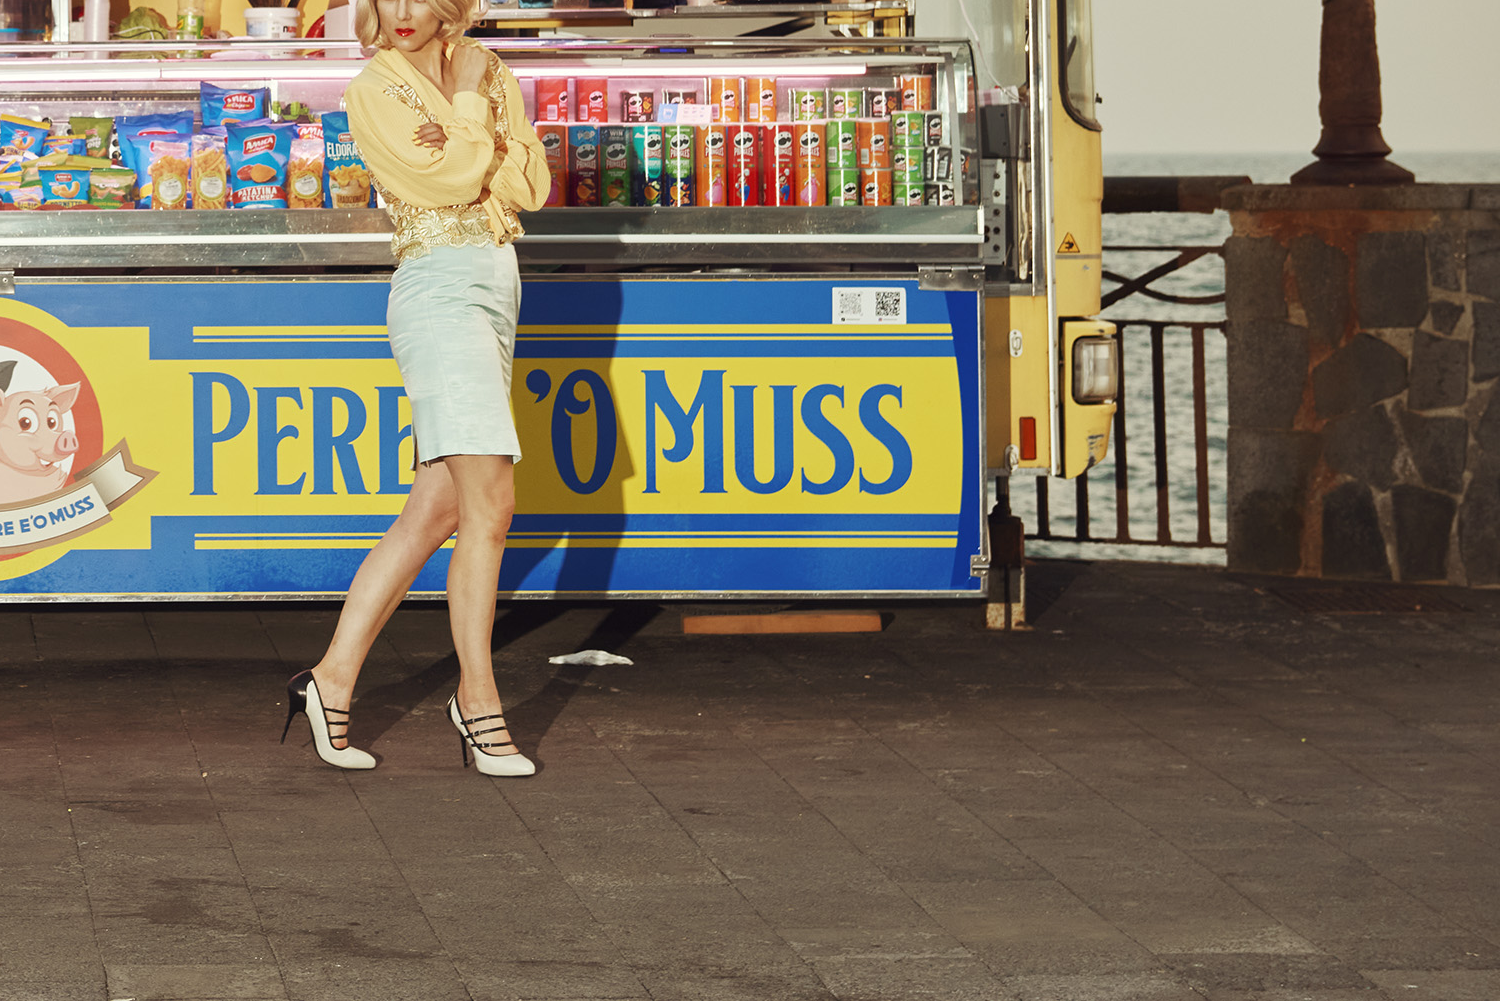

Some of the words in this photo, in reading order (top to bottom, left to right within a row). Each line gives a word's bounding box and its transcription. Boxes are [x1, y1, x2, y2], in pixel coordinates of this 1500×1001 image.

[326, 141, 359, 158] ELDORA
[188, 371, 412, 496] PERE
[641, 368, 913, 496] MUSS
[19, 514, 48, 534] E'O
[48, 495, 96, 526] MUSS
